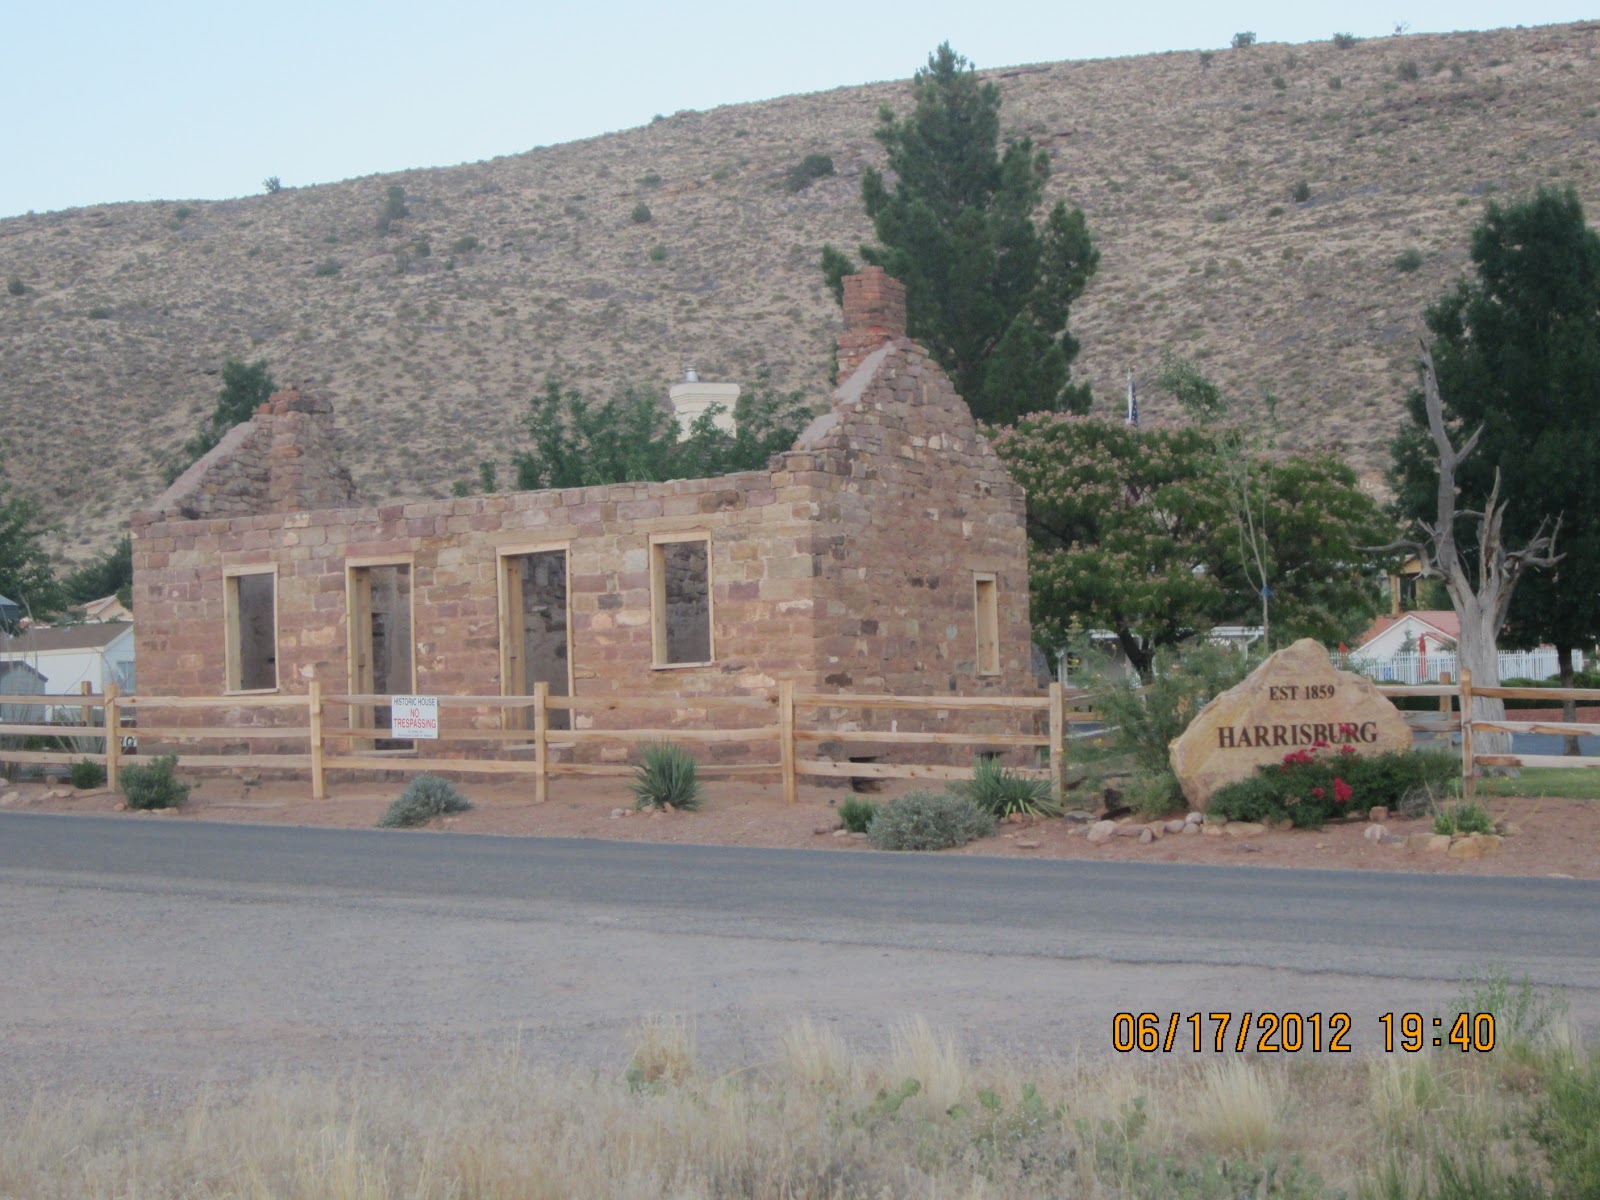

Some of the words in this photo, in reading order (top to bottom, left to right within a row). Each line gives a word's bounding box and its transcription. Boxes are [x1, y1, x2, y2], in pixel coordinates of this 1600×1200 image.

[1269, 685, 1299, 701] EST
[1305, 684, 1335, 700] 1859
[394, 697, 416, 706] HISTORIC
[418, 697, 434, 706] HOUSE
[410, 708, 419, 718] NO
[394, 718, 436, 728] TRESPASSING
[1218, 722, 1378, 748] HARRISBURG
